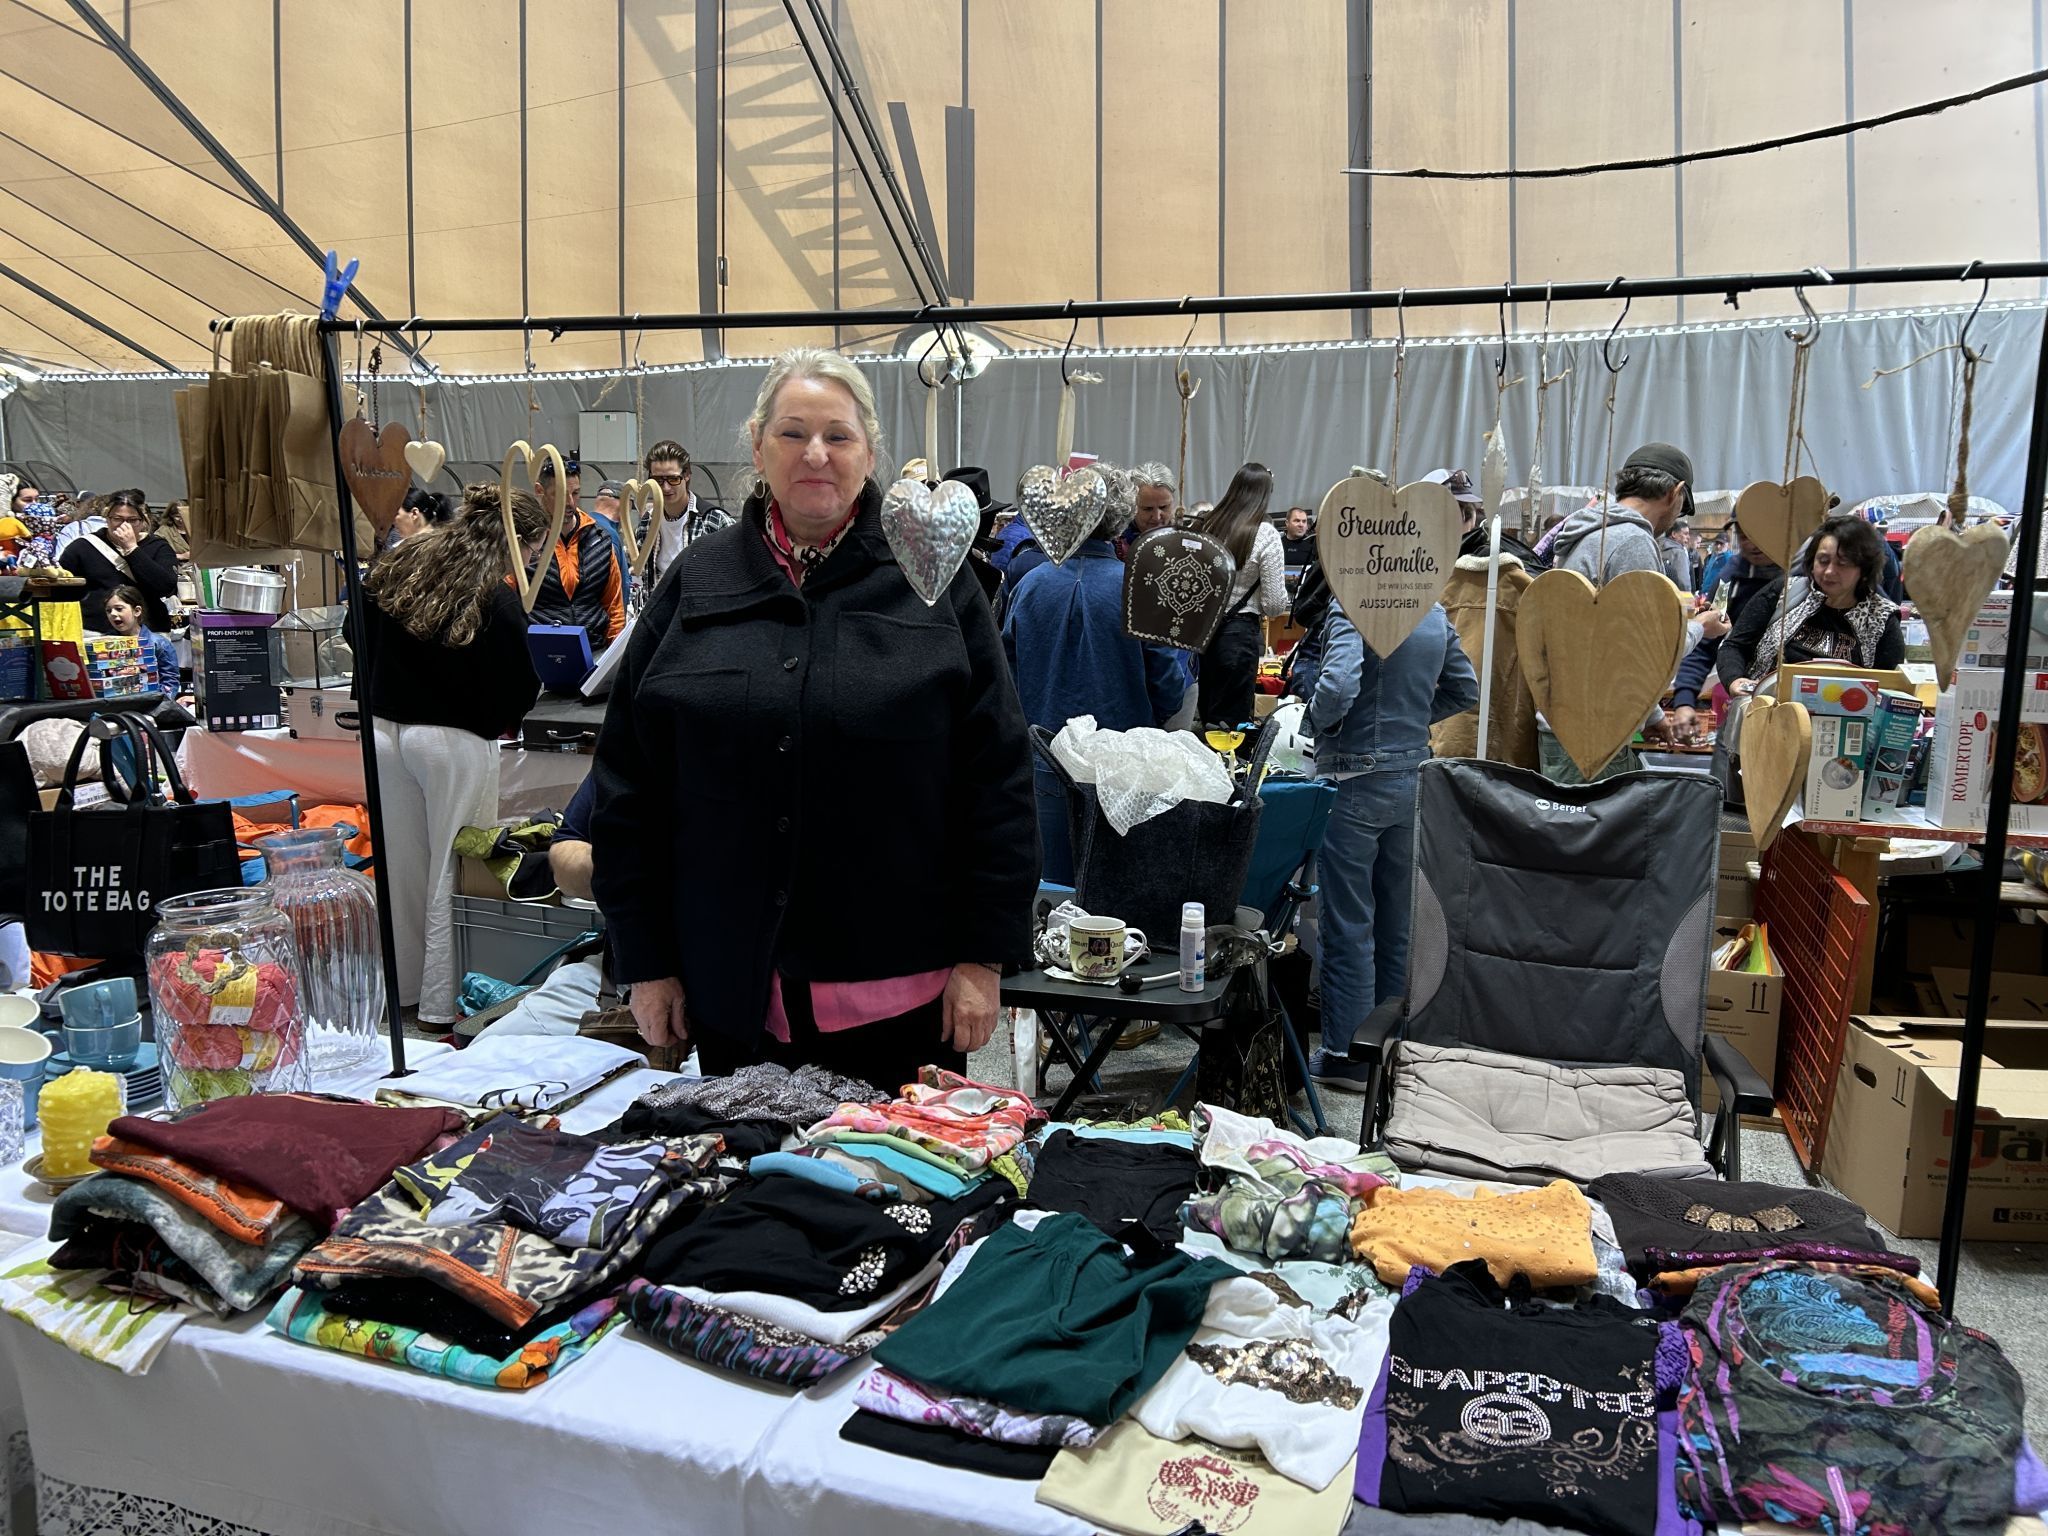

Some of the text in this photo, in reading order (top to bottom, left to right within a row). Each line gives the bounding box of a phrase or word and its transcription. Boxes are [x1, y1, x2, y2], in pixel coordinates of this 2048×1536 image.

[1338, 506, 1421, 538] Freunde,
[1367, 544, 1439, 575] Familie,
[1359, 598, 1419, 609] AUSSUCHEN
[1952, 720, 1974, 802] RÖMERTOPF
[1552, 802, 1587, 813] Berger
[73, 865, 121, 888] THE
[106, 890, 150, 911] BAG
